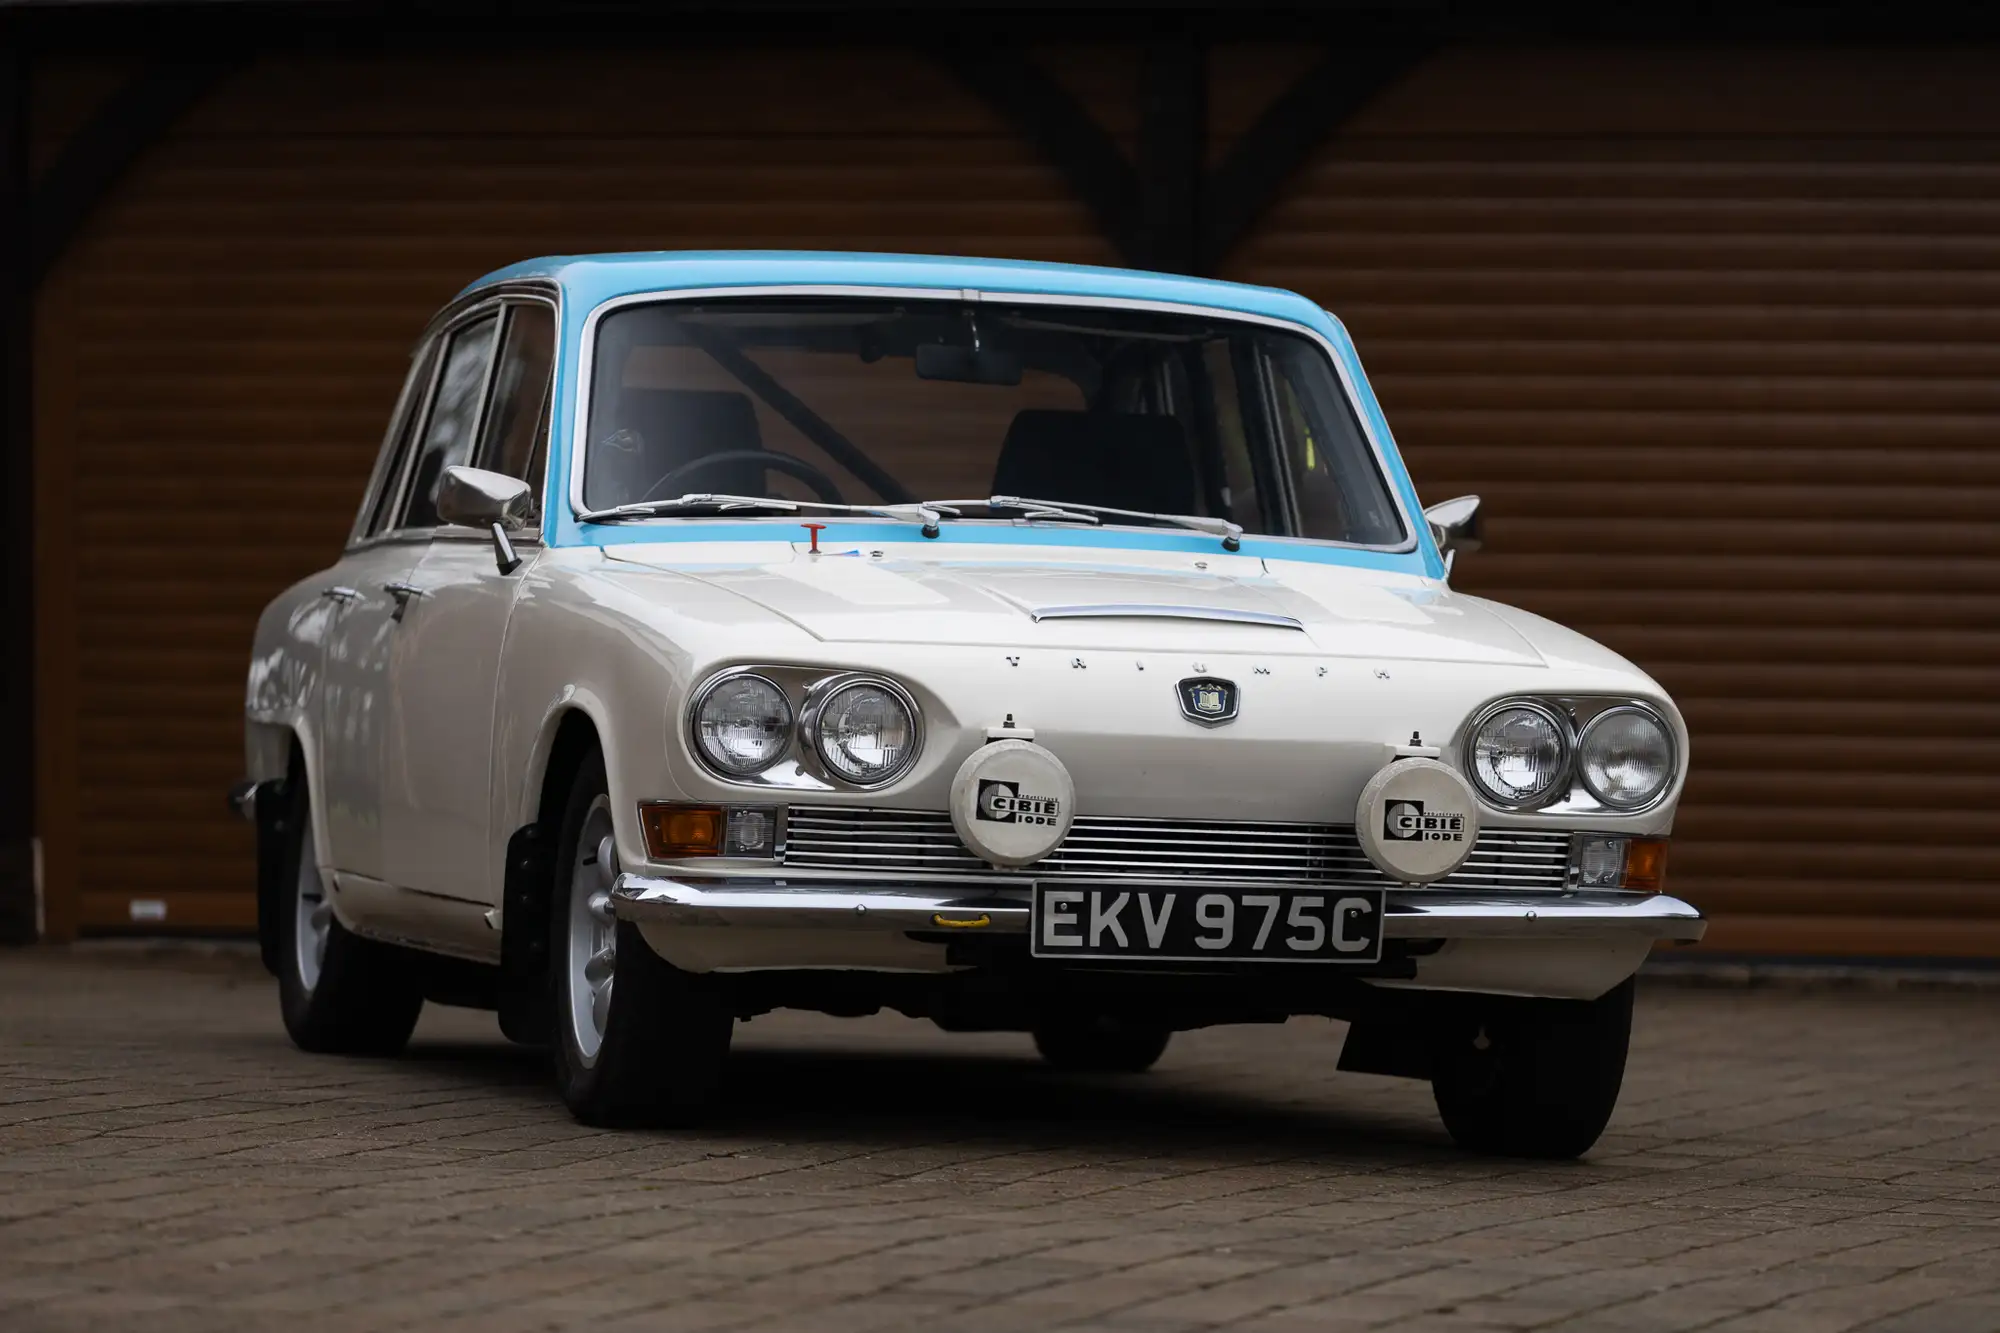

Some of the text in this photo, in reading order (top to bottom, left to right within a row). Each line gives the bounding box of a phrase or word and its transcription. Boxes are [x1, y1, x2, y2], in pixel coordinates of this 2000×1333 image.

[1006, 656, 1390, 679] TRIUMPH
[1018, 815, 1056, 826] IODE
[1424, 832, 1463, 841] IODE
[1043, 891, 1372, 952] EKV 975C
